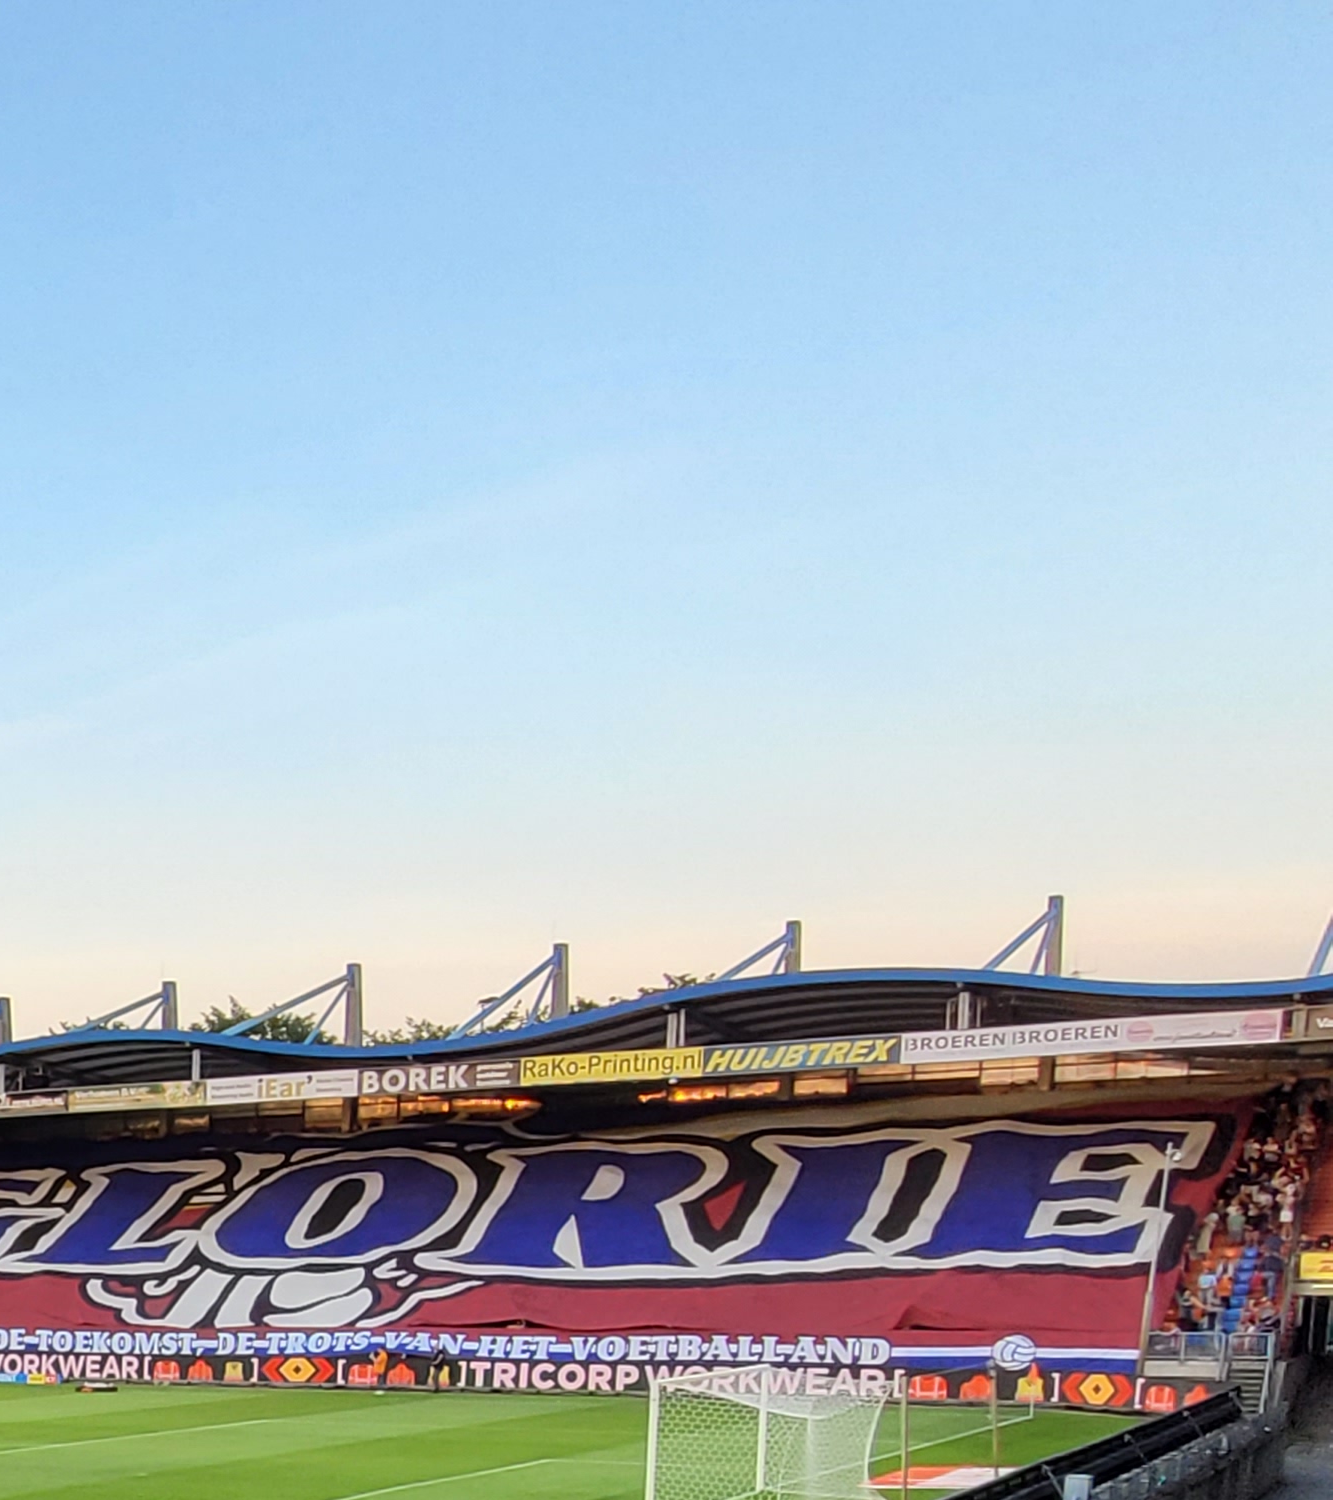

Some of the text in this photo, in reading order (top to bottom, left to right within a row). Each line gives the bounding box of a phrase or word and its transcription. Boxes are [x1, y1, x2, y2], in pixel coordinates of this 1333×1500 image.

[905, 1031, 1006, 1052] BROEREN
[1012, 1024, 1119, 1046] BROEREN
[522, 1049, 702, 1079] RaKo-Printing.nl
[704, 1038, 899, 1073] HUIJBTREX
[362, 1064, 468, 1095] BOREK
[215, 1331, 256, 1355] DE
[264, 1330, 371, 1356] TROTS
[383, 1331, 466, 1355] VAN
[477, 1333, 556, 1360] HET
[569, 1333, 891, 1365] VOETBALLAND
[471, 1361, 884, 1397] TRICORP WORKWEAR
